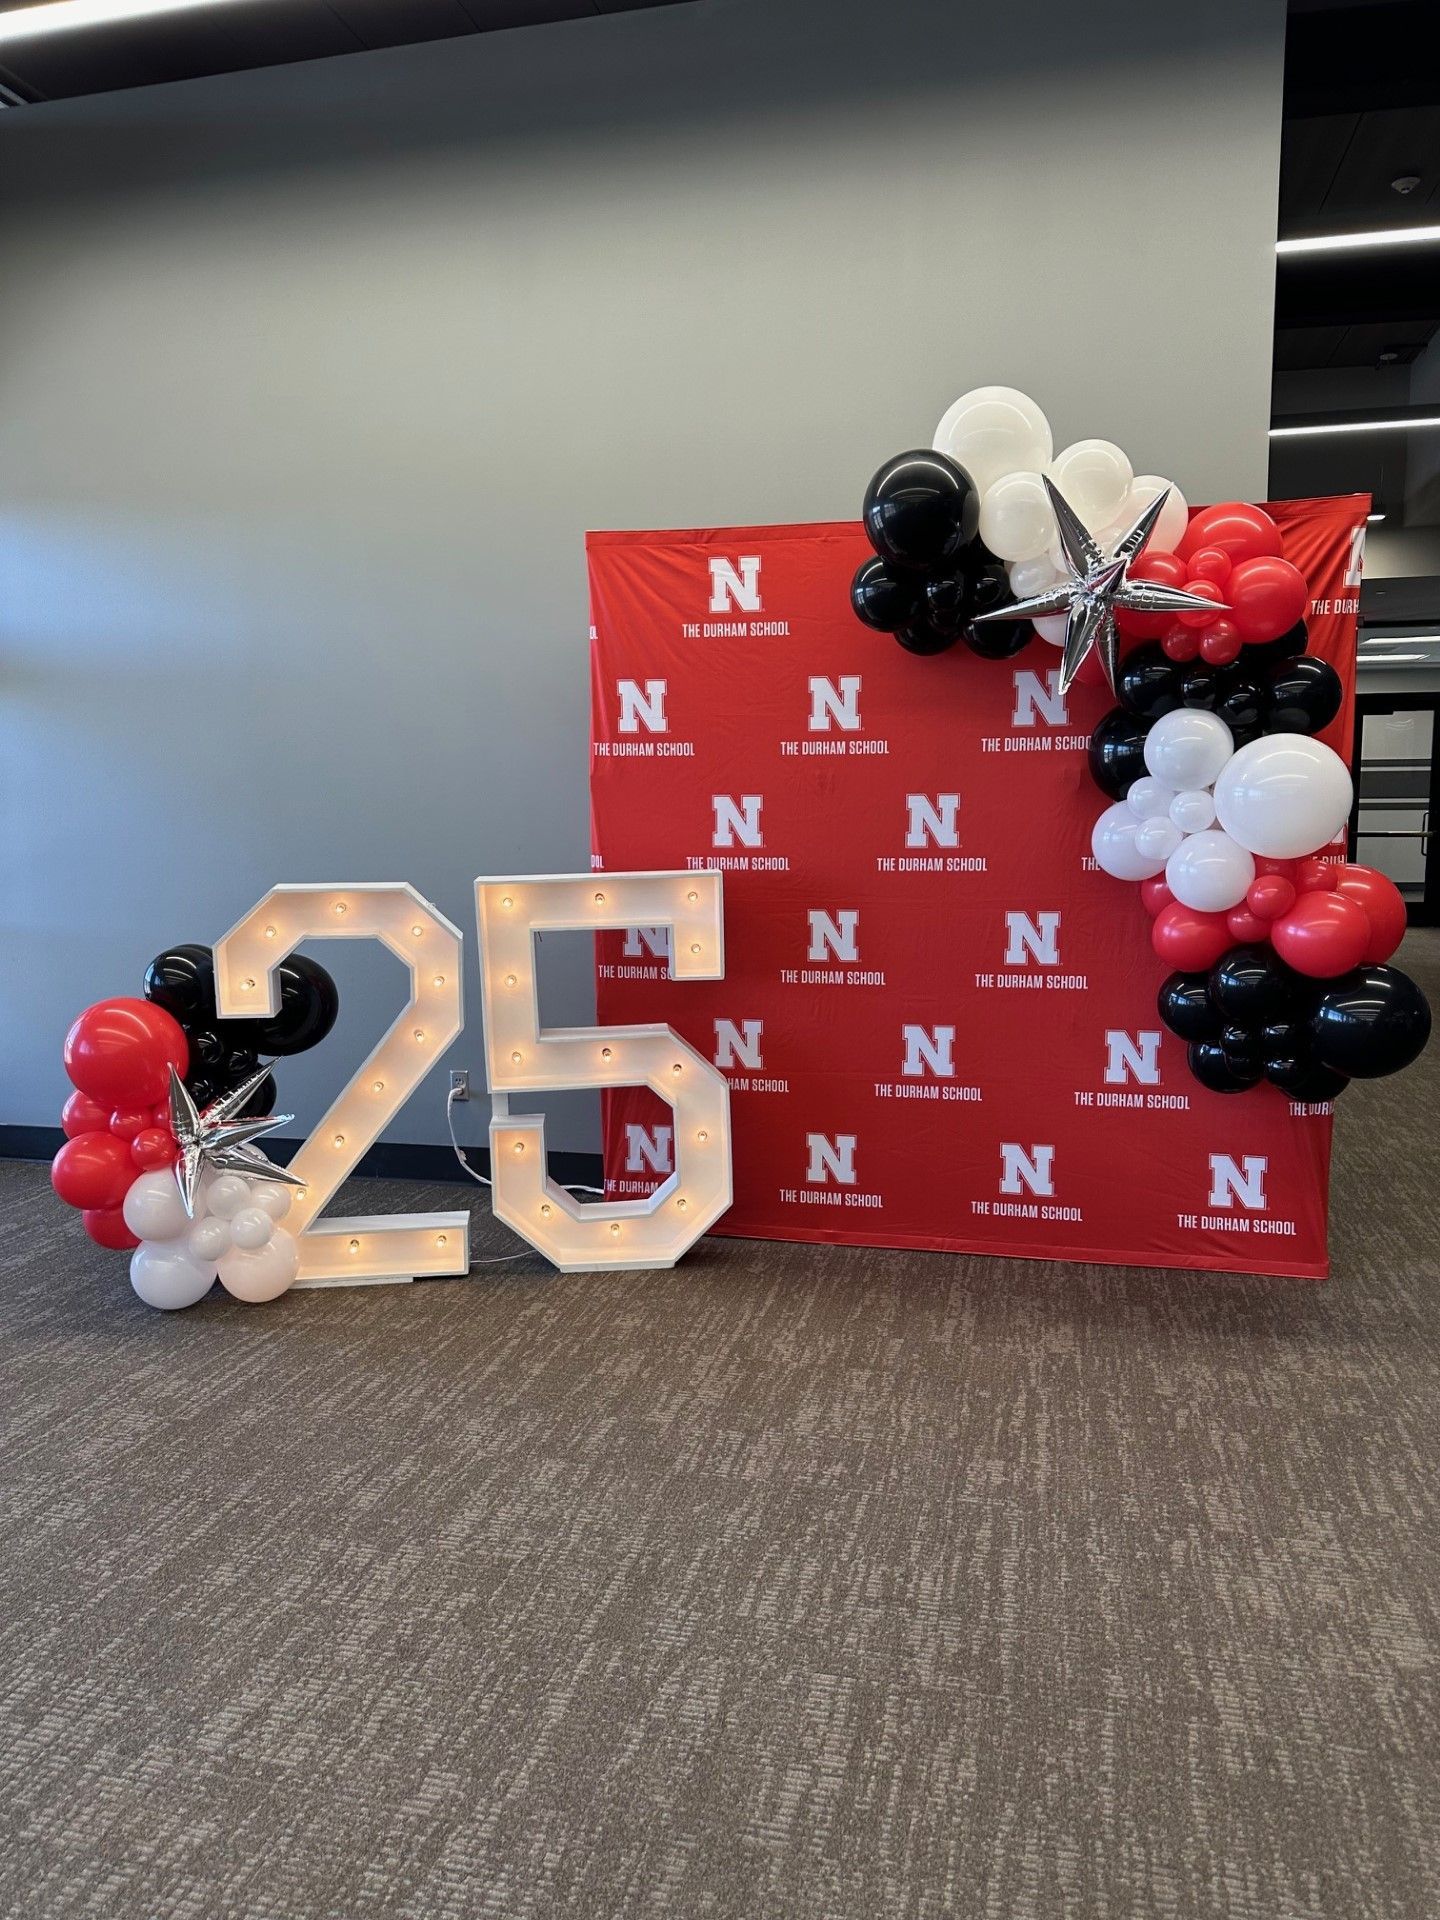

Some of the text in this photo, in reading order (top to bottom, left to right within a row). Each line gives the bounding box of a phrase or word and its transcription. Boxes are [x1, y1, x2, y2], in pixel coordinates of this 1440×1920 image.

[708, 555, 762, 613] N
[1311, 599, 1360, 614] THE DURH
[682, 621, 790, 638] THE DURHAM SCHOOL
[616, 679, 667, 733] N
[808, 675, 862, 731] N
[1011, 669, 1069, 727] N
[593, 742, 695, 756] THE DURHAM SCHOOL
[780, 740, 889, 756] THE DURHAM SCHOOL
[981, 736, 1092, 752] THE DURHAM SCHOO
[711, 794, 763, 848] N
[905, 793, 960, 848] N
[686, 856, 790, 871] THE DURHAM SCHOOL
[876, 857, 987, 872] THE DURHAM SCHOOL
[807, 909, 859, 962] N
[1003, 911, 1061, 966] N
[598, 965, 615, 978] THE
[617, 965, 658, 980] DURHAM
[780, 970, 886, 986] THE DURHAM SCHOOL
[975, 974, 1088, 990] THE DURHAM SCHOOL
[713, 1018, 763, 1070] N
[902, 1024, 955, 1078] N
[1104, 1029, 1162, 1086] N
[728, 1078, 790, 1093] HAM SCHOOL
[874, 1084, 983, 1102] THE DURHAM SCHOOL
[1074, 1091, 1190, 1110] THE DURHAM SCHOOL
[1289, 1102, 1307, 1116] THE
[625, 1123, 672, 1174] N
[806, 1132, 857, 1185] N
[999, 1143, 1055, 1196] N
[619, 1180, 659, 1194] DURHAM
[1208, 1153, 1267, 1210] N
[779, 1189, 883, 1208] THE DURHAM SCHOOL
[971, 1201, 1083, 1221] THE DURHAM SCHOOL
[1178, 1214, 1297, 1236] THE DURHAM SCHOOL
